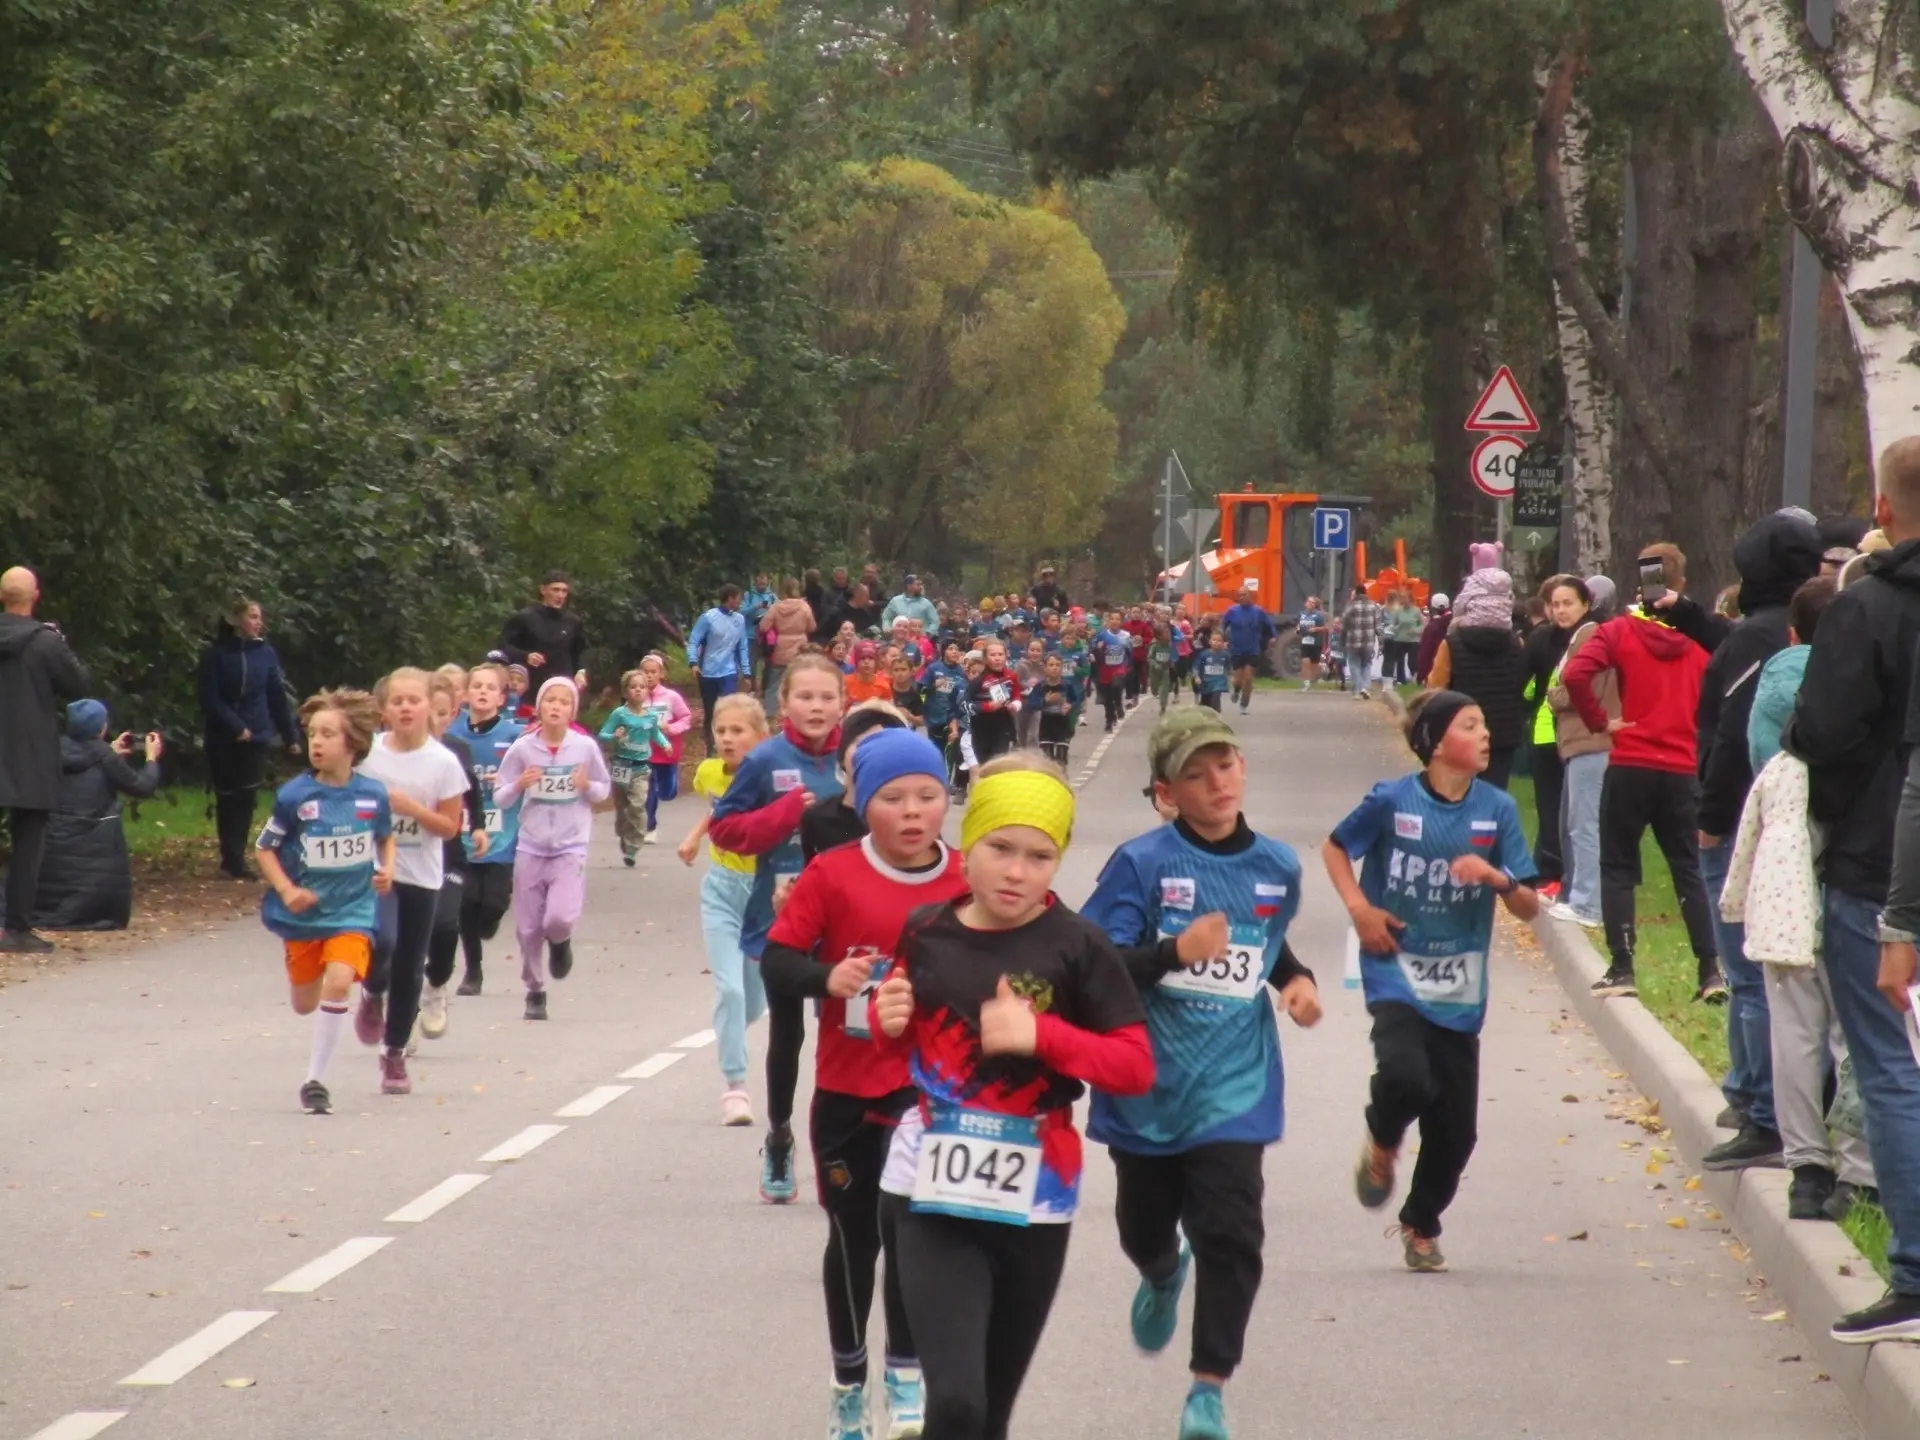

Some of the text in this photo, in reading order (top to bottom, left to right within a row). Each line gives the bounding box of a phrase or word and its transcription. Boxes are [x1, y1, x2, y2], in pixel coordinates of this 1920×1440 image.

[1484, 454, 1516, 477] 40
[1323, 513, 1343, 545] P
[611, 767, 628, 779] 51
[392, 818, 419, 836] 44
[316, 836, 366, 859] 1135
[1389, 847, 1482, 888] КРОС
[1386, 875, 1483, 904] НАЦИИ
[1176, 948, 1251, 984] 053
[929, 1141, 1026, 1194] 1042
